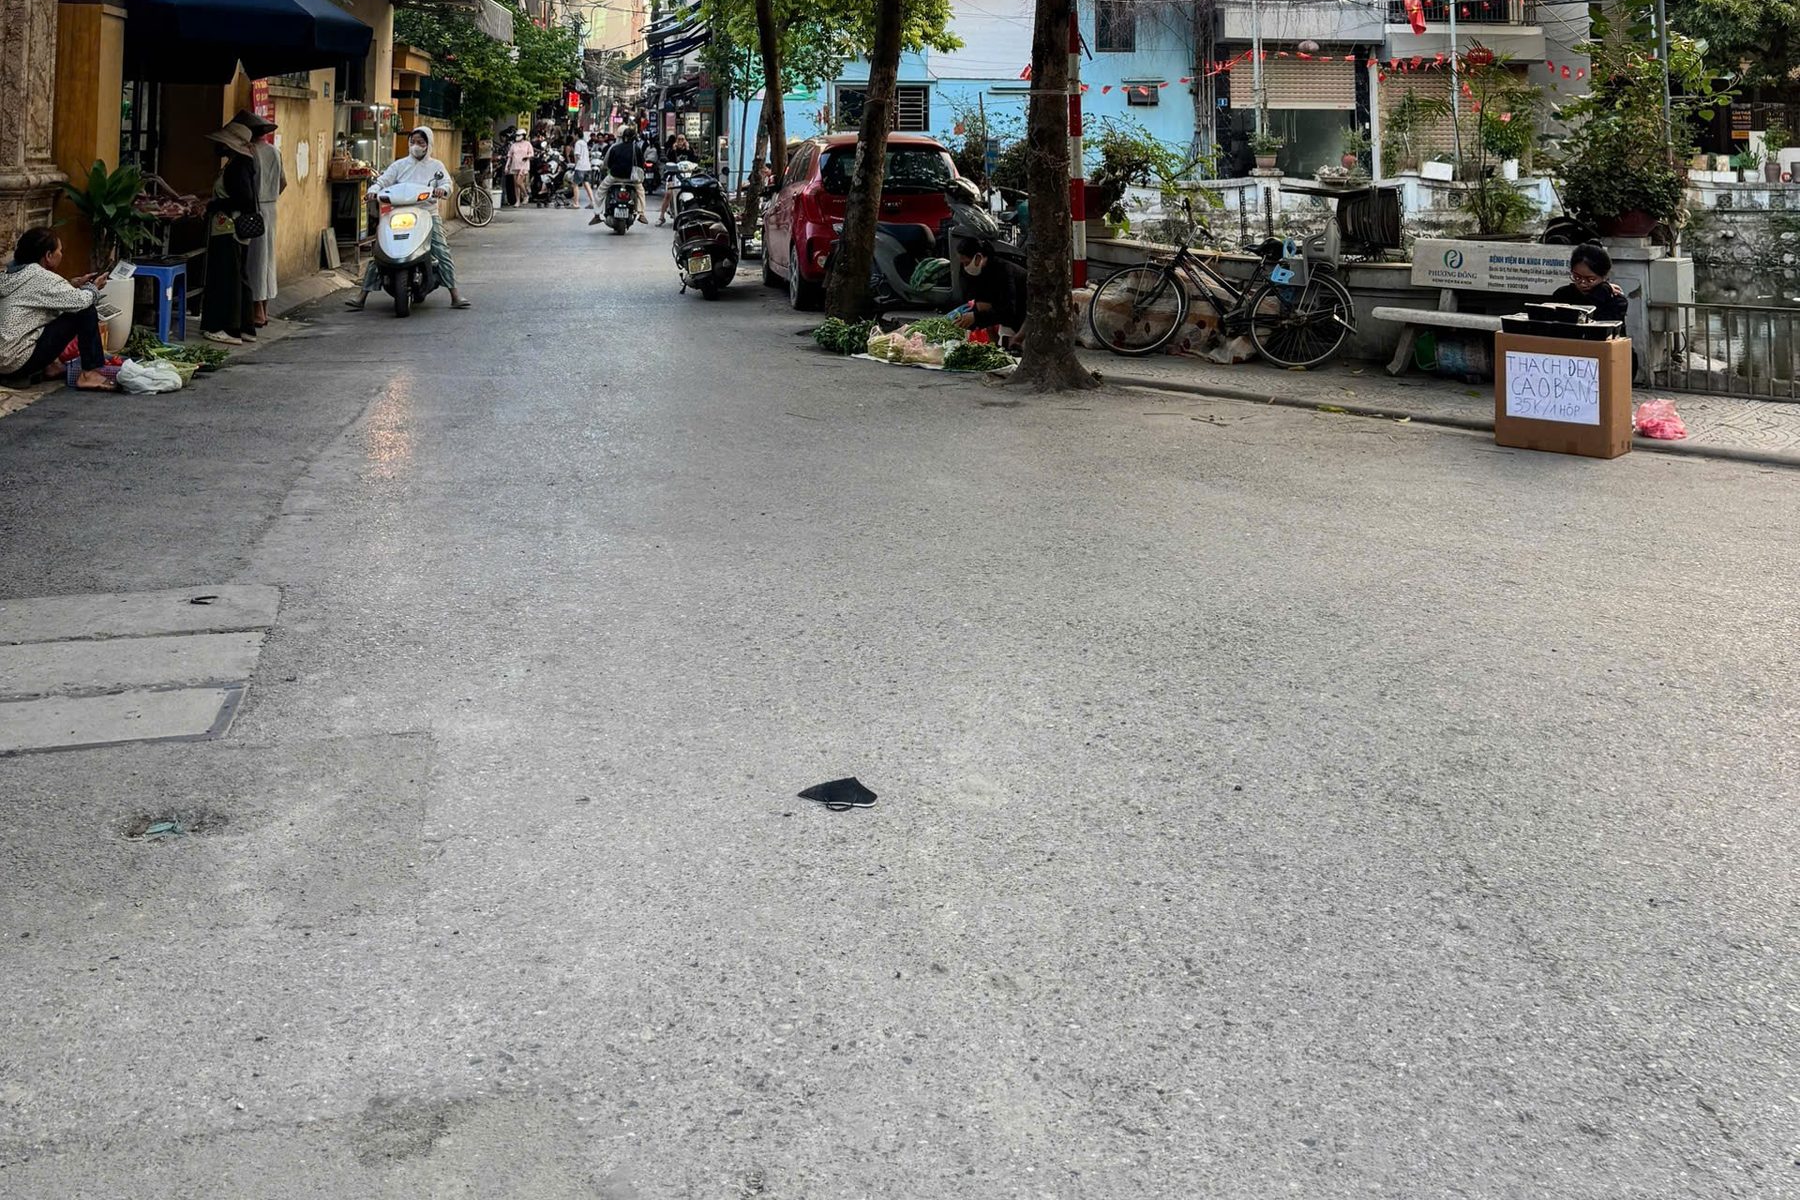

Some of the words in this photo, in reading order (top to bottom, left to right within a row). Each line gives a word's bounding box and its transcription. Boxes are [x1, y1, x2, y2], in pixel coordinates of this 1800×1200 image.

[1506, 355, 1562, 377] THẠCH
[1568, 358, 1598, 380] ĐEN
[1511, 376, 1550, 398] CAO
